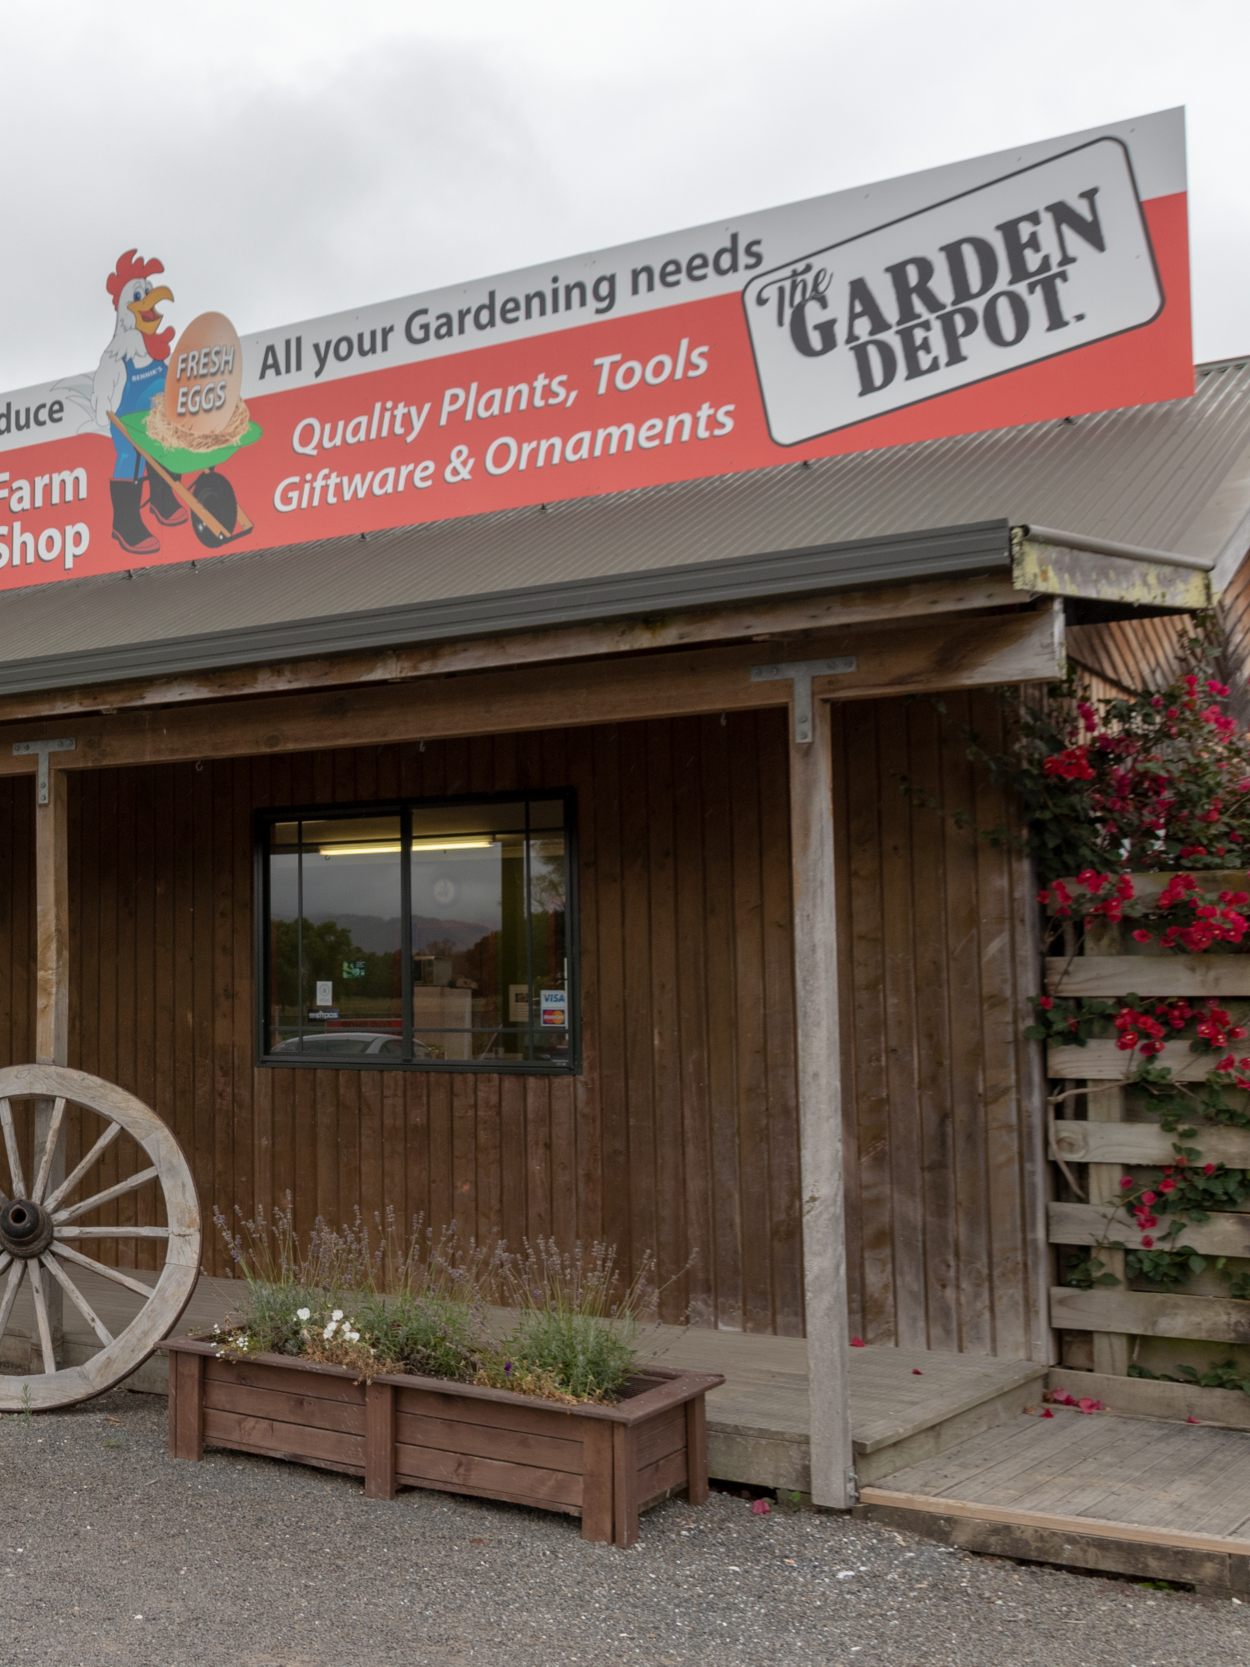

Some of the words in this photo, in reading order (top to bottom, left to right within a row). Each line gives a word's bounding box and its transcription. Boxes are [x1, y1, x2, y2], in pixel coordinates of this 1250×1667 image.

[756, 262, 834, 327] The
[789, 187, 1107, 358] GARDEN
[258, 335, 302, 380] All
[313, 324, 394, 378] your
[405, 273, 617, 345] Gardening
[631, 232, 763, 297] needs
[131, 366, 163, 381] BENNIK'S
[176, 345, 235, 381] FRESH
[176, 381, 227, 415] EGGS
[291, 399, 432, 457] Quality
[438, 372, 579, 427] Plants,
[593, 338, 710, 396] Tools
[273, 459, 435, 513] Giftware
[443, 444, 476, 485] &
[484, 402, 736, 476] Ornaments
[543, 994, 565, 1002] VISA
